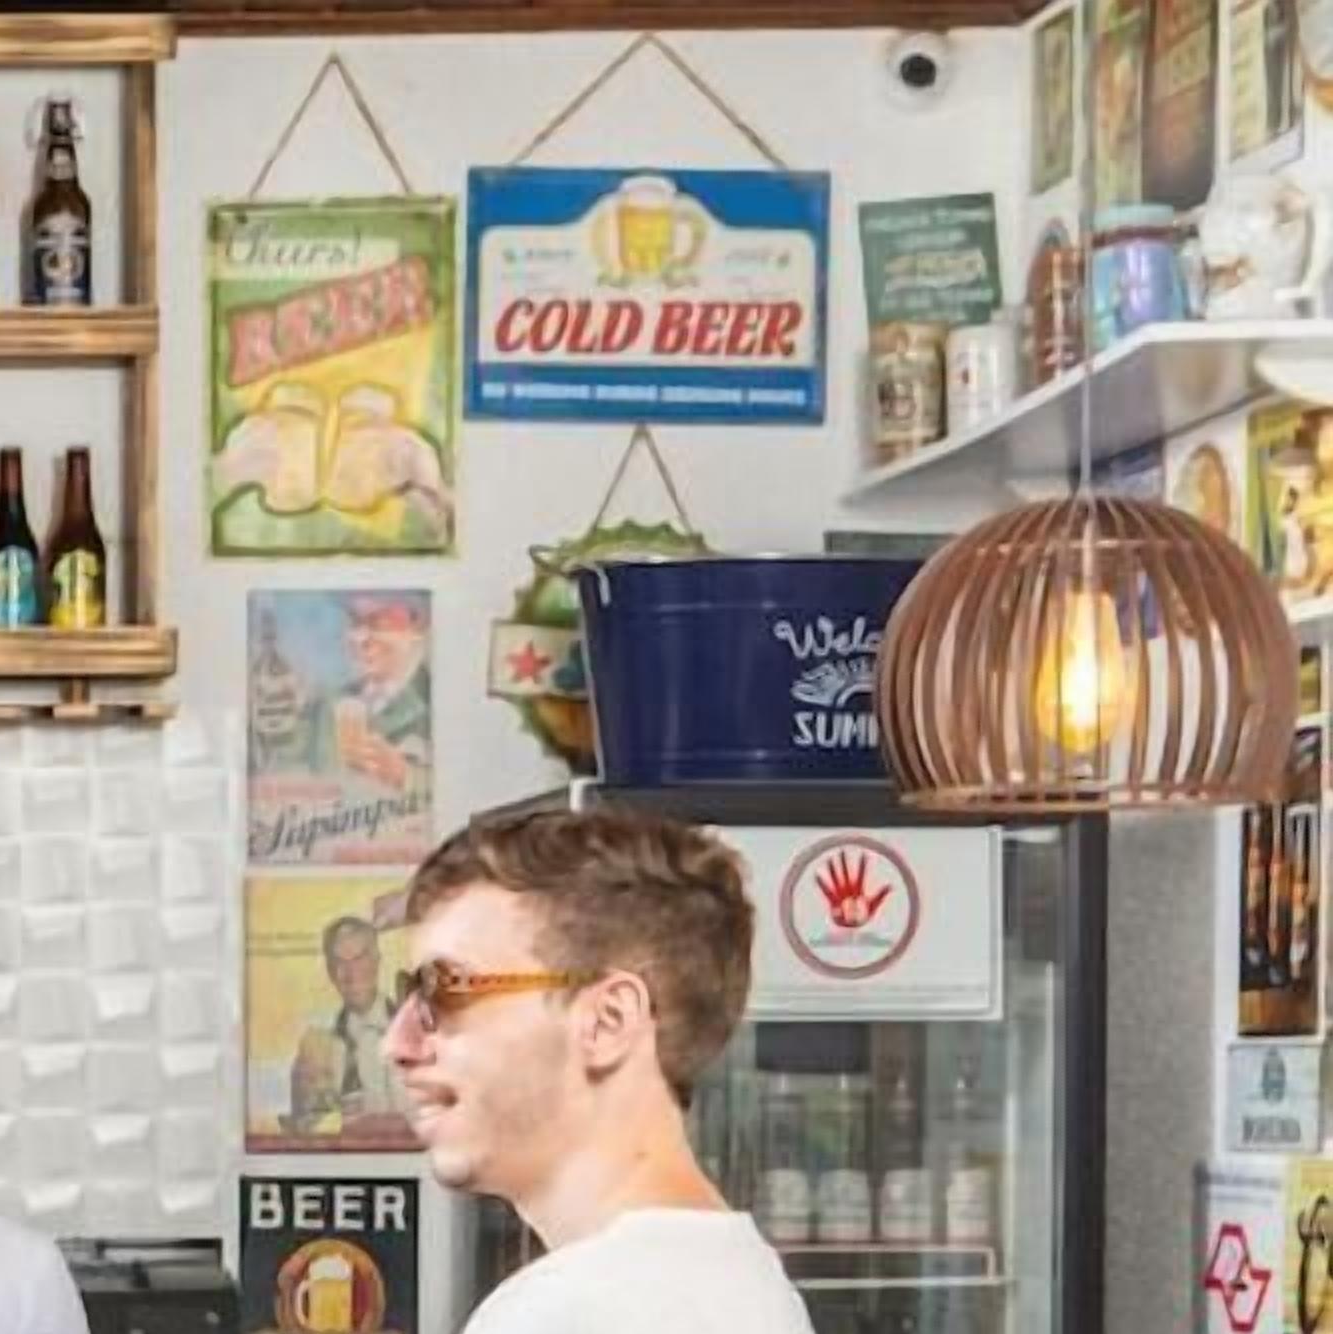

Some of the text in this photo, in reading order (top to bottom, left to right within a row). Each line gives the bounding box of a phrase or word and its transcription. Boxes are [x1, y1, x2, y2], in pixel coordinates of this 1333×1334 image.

[494, 297, 802, 357] COLD BEER
[249, 1182, 407, 1231] BEER
